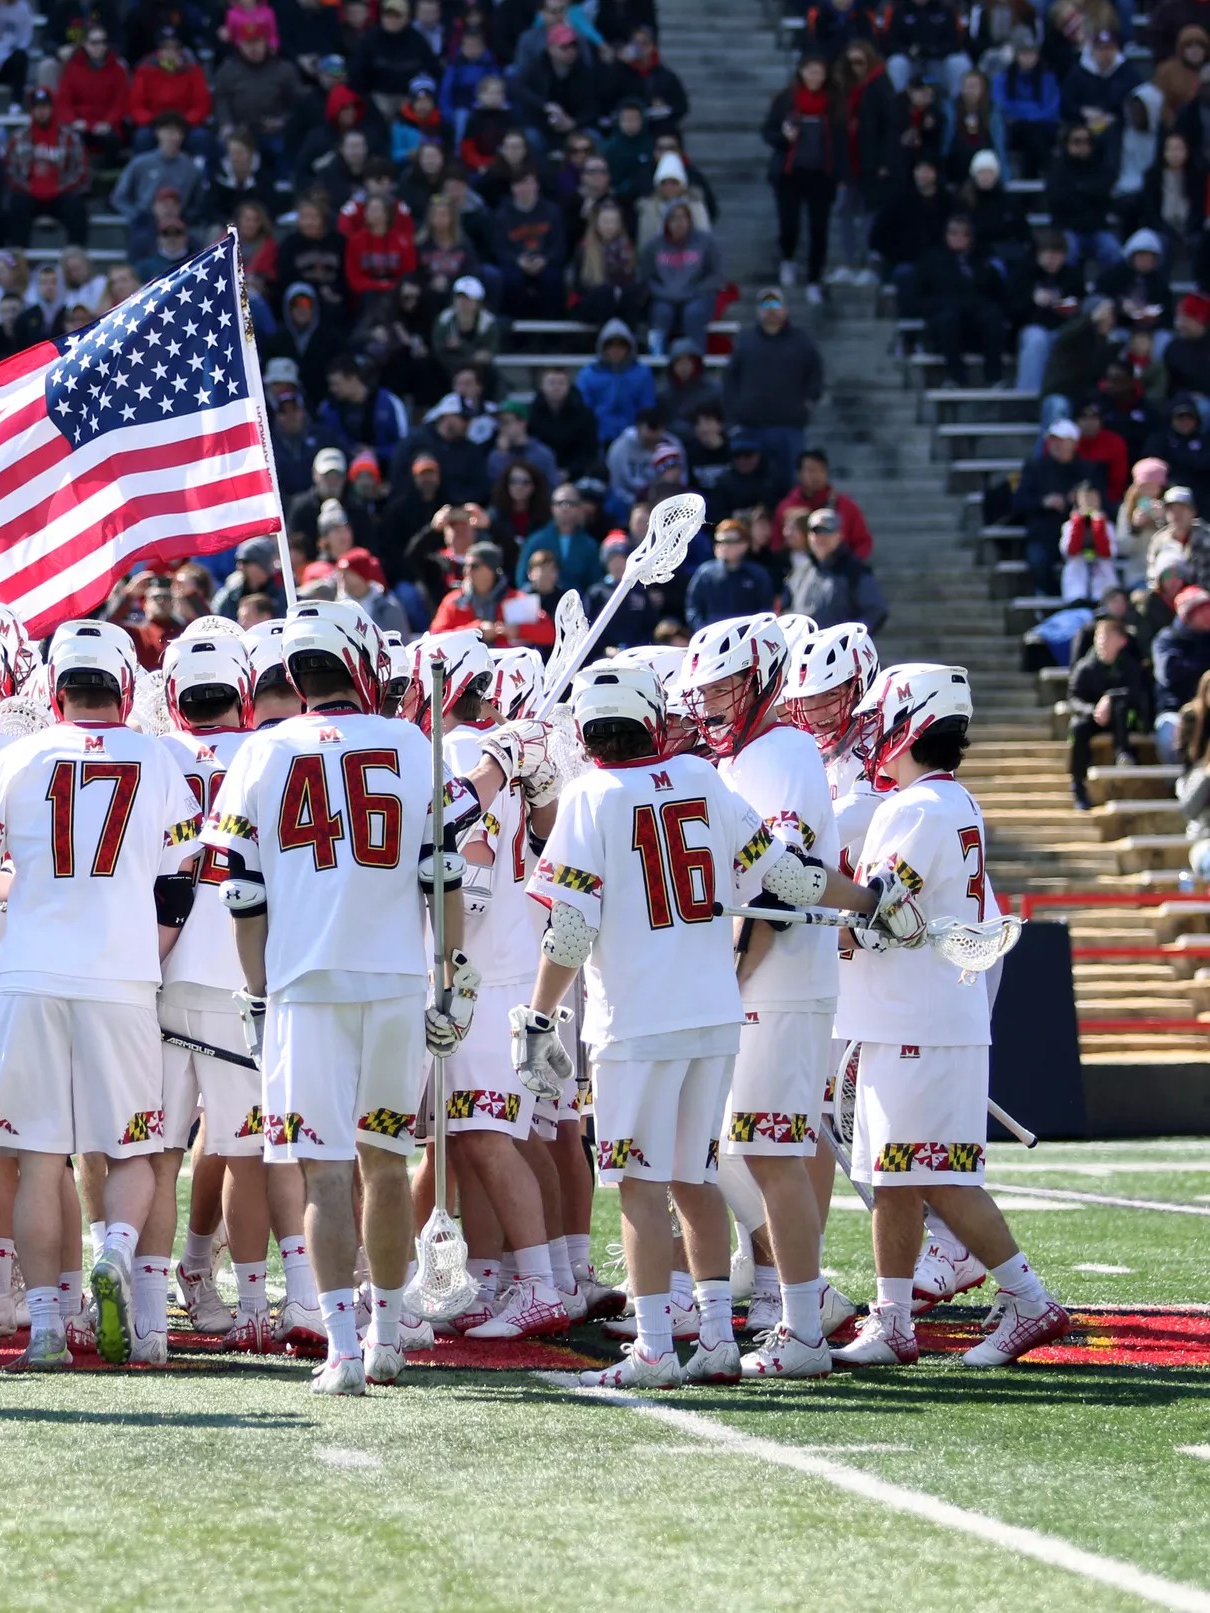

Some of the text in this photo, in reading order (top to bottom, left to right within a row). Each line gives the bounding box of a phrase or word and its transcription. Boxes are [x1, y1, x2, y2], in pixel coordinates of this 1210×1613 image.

[355, 615, 368, 637] M
[763, 638, 780, 655] M
[862, 644, 874, 662] M
[509, 669, 526, 688] M
[897, 682, 911, 700] M
[85, 736, 104, 750] M
[318, 726, 341, 742] M
[197, 745, 218, 760] M
[649, 770, 673, 789] M
[45, 760, 141, 878] 17
[278, 748, 402, 872] 46
[632, 797, 715, 931] 16
[167, 1037, 216, 1057] ARMOUR
[928, 1245, 939, 1256] M
